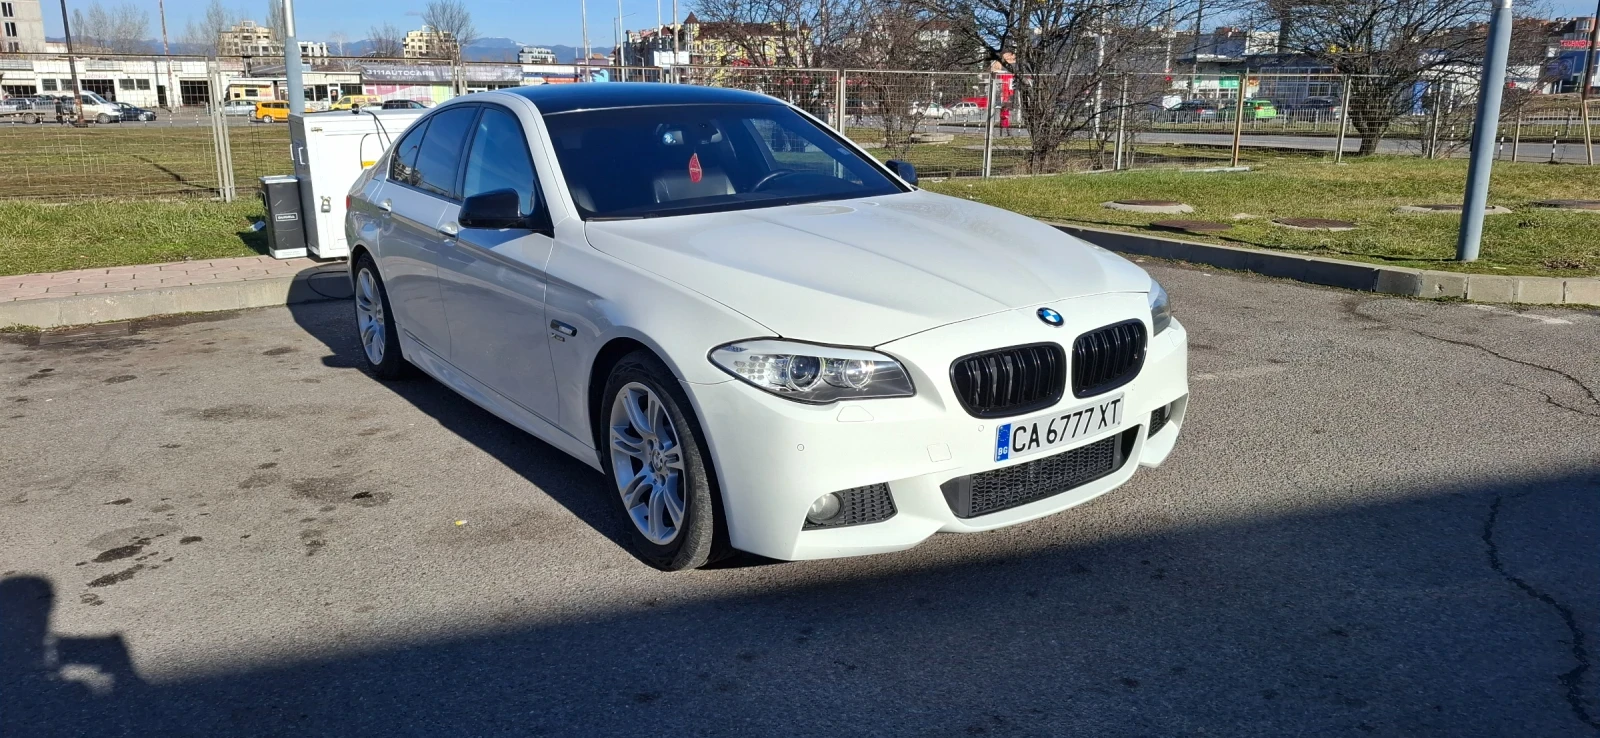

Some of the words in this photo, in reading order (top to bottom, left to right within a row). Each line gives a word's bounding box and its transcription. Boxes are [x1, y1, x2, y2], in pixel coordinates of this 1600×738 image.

[1012, 422, 1040, 453] CA
[1046, 407, 1095, 444] 6777
[1097, 398, 1121, 430] XT
[998, 446, 1008, 456] BG
